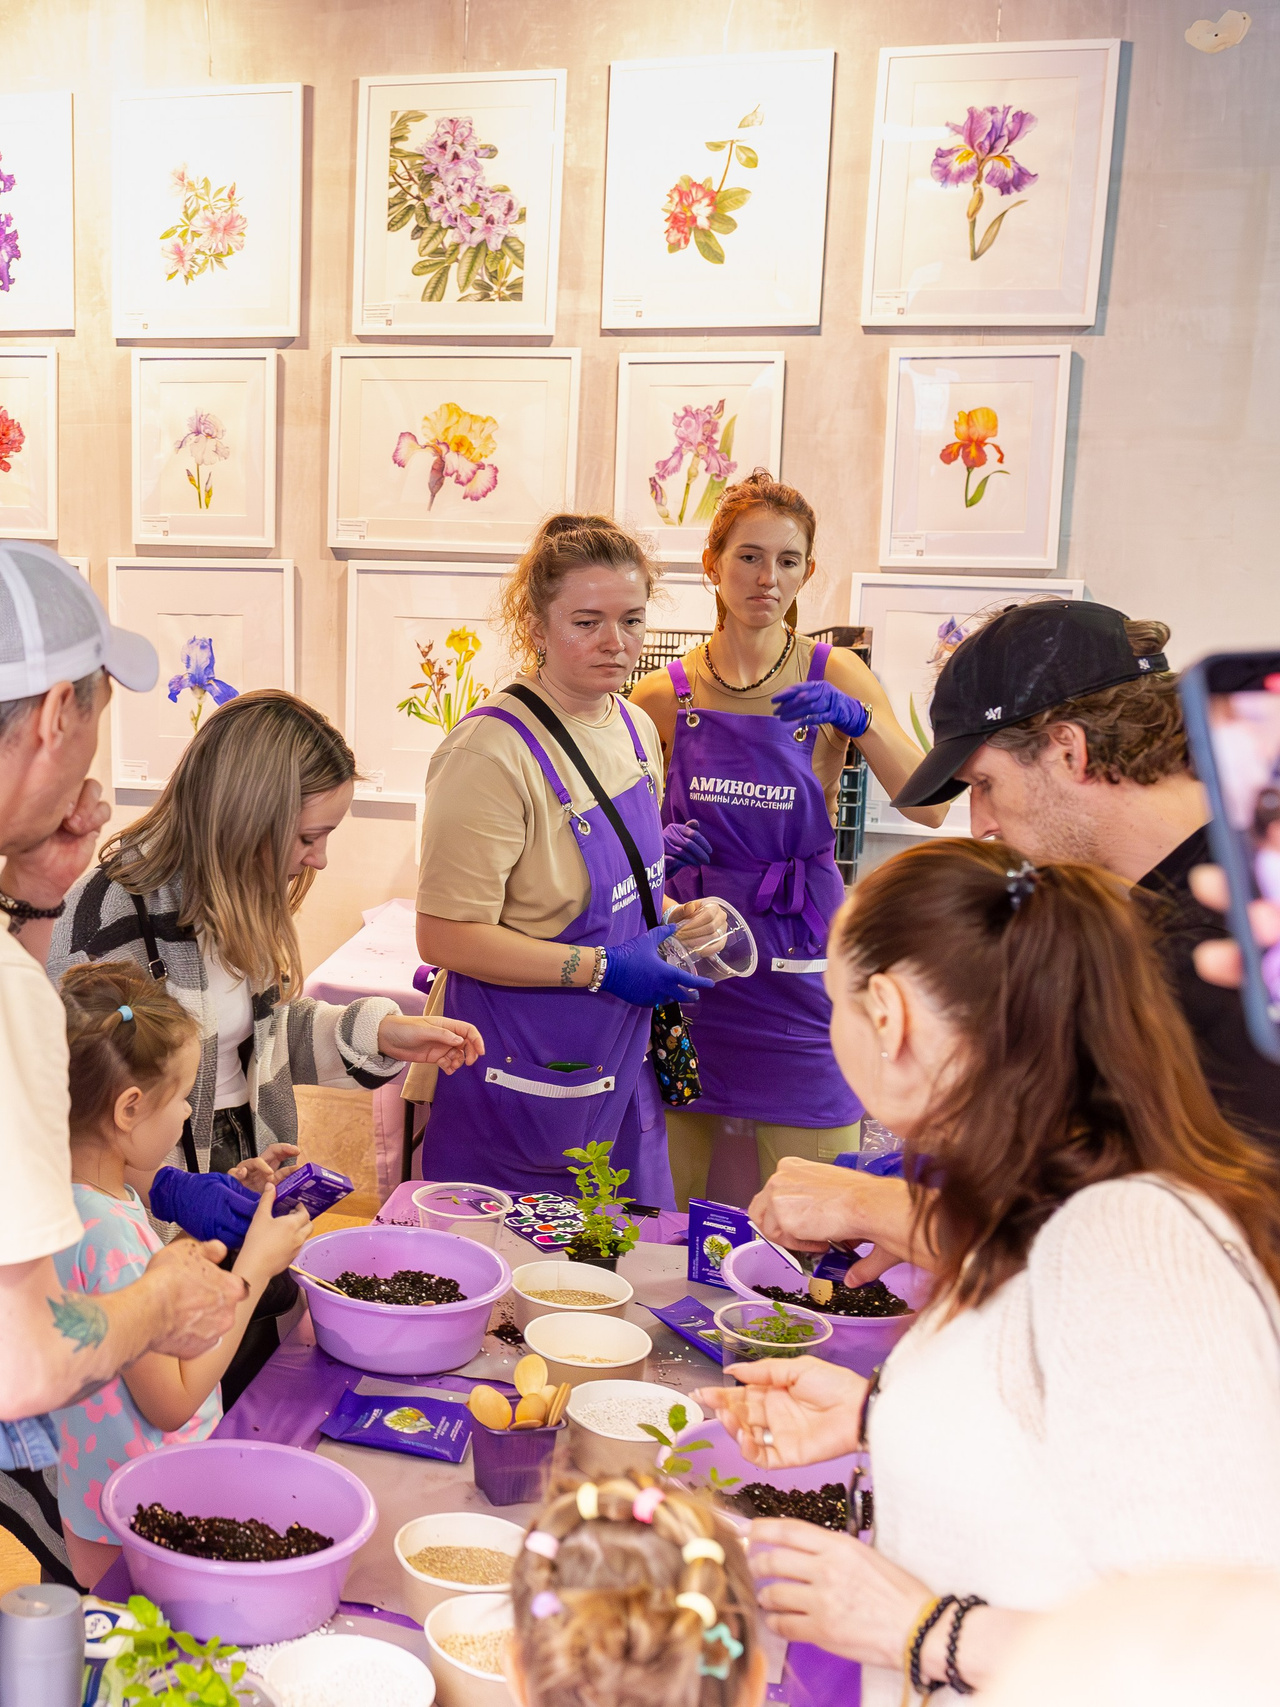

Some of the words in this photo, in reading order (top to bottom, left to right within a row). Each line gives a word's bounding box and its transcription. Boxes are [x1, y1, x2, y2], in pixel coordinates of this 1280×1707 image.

[689, 776, 797, 801] АМИНОСИЛ
[689, 792, 730, 804] ВИТАМИНЫ
[731, 797, 749, 806] ДЛЯ
[750, 799, 793, 810] РАСТЕНИЙ
